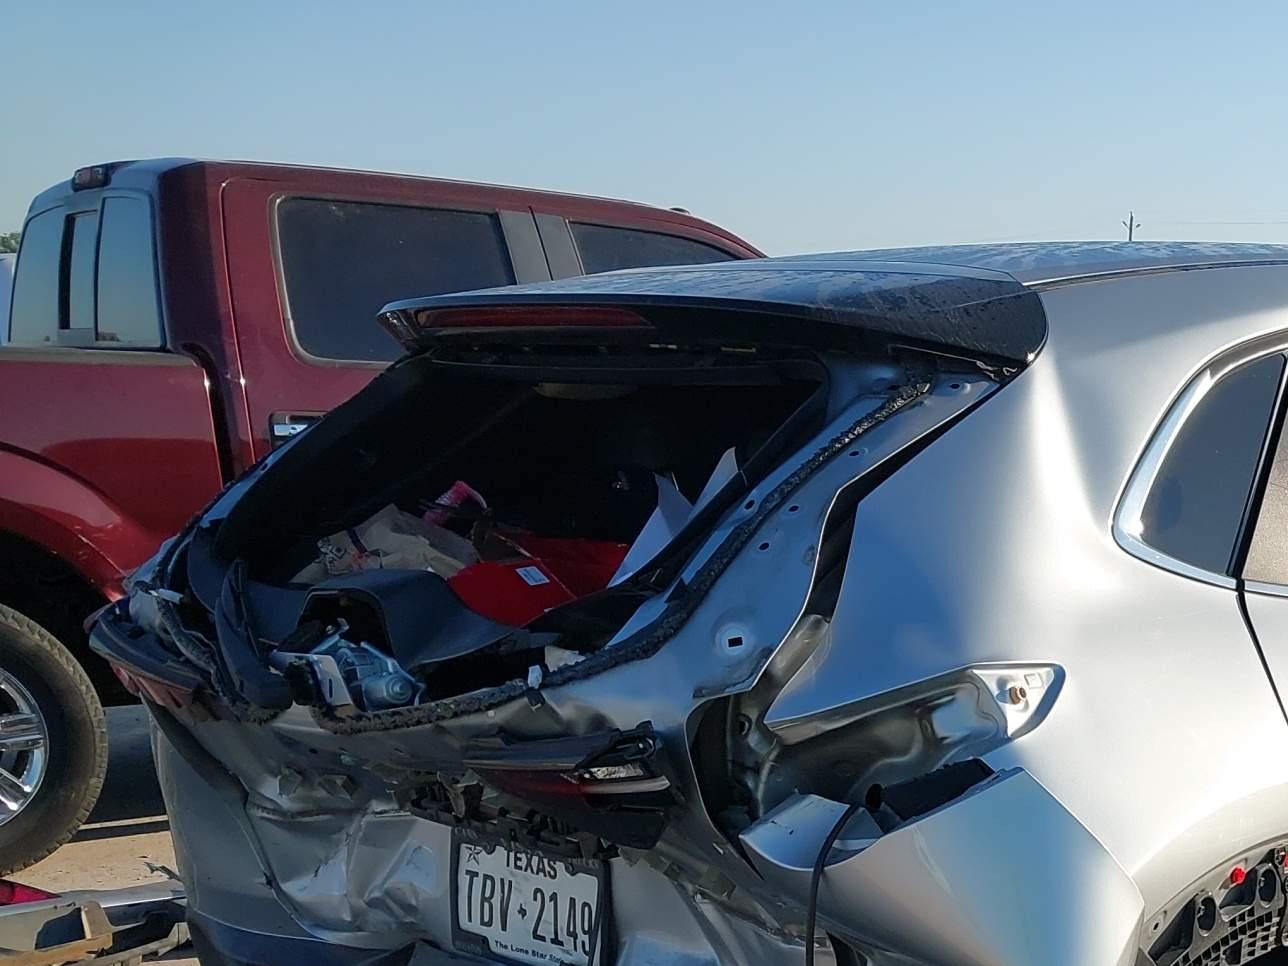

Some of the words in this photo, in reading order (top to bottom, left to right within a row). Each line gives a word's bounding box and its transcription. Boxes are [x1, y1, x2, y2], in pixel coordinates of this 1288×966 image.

[503, 847, 559, 880] TEXAS
[464, 869, 513, 932] TBV
[532, 887, 593, 957] 2149
[494, 939, 509, 950] The
[510, 943, 530, 956] Lone
[531, 949, 548, 960] Star
